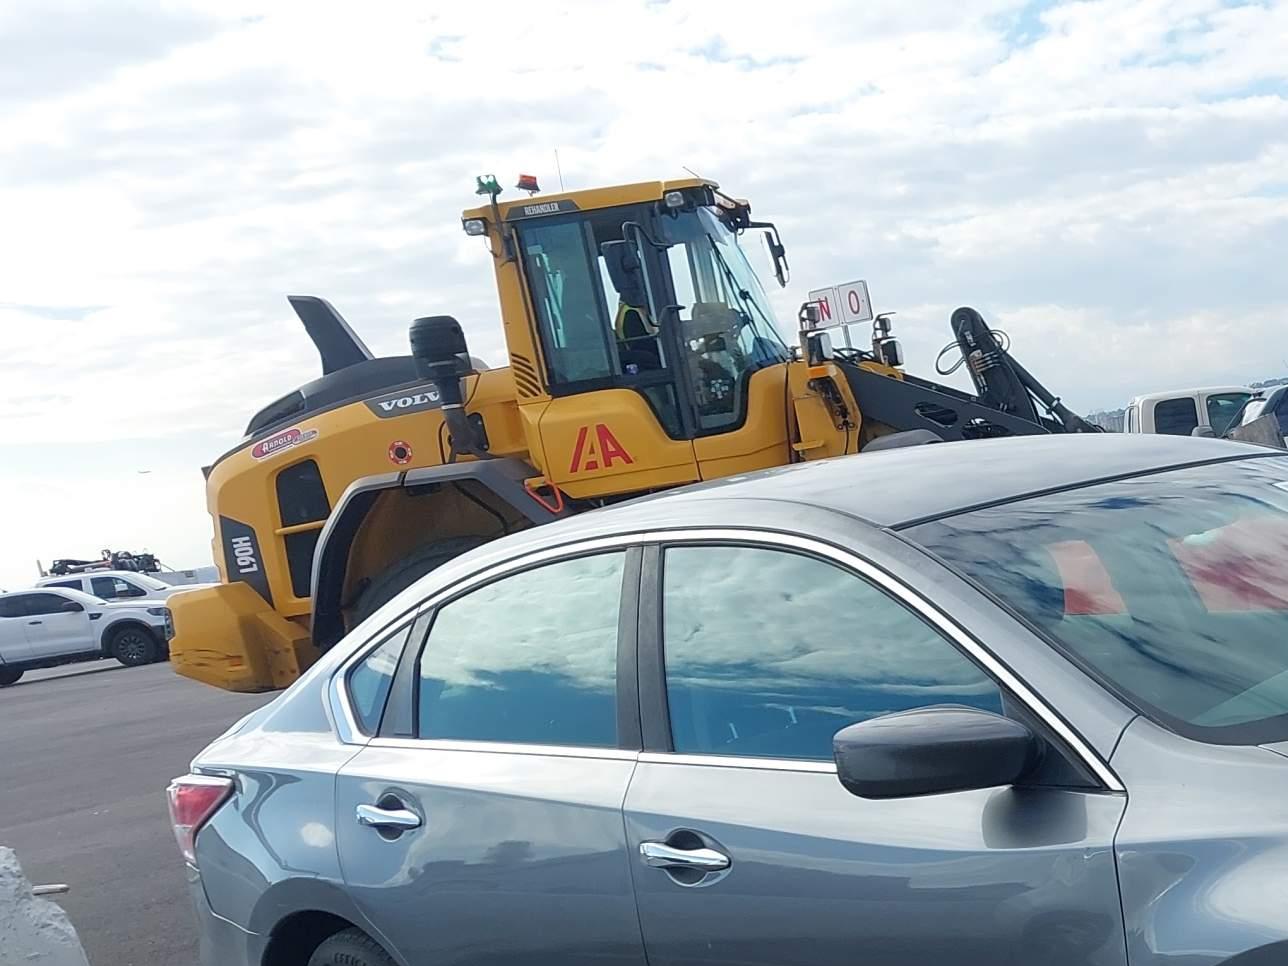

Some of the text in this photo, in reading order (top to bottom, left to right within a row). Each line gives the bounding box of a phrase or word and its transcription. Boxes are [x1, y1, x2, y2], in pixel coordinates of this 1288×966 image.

[524, 202, 560, 216] REHANDLER
[378, 391, 440, 411] VOLV
[231, 536, 258, 573] L90H
